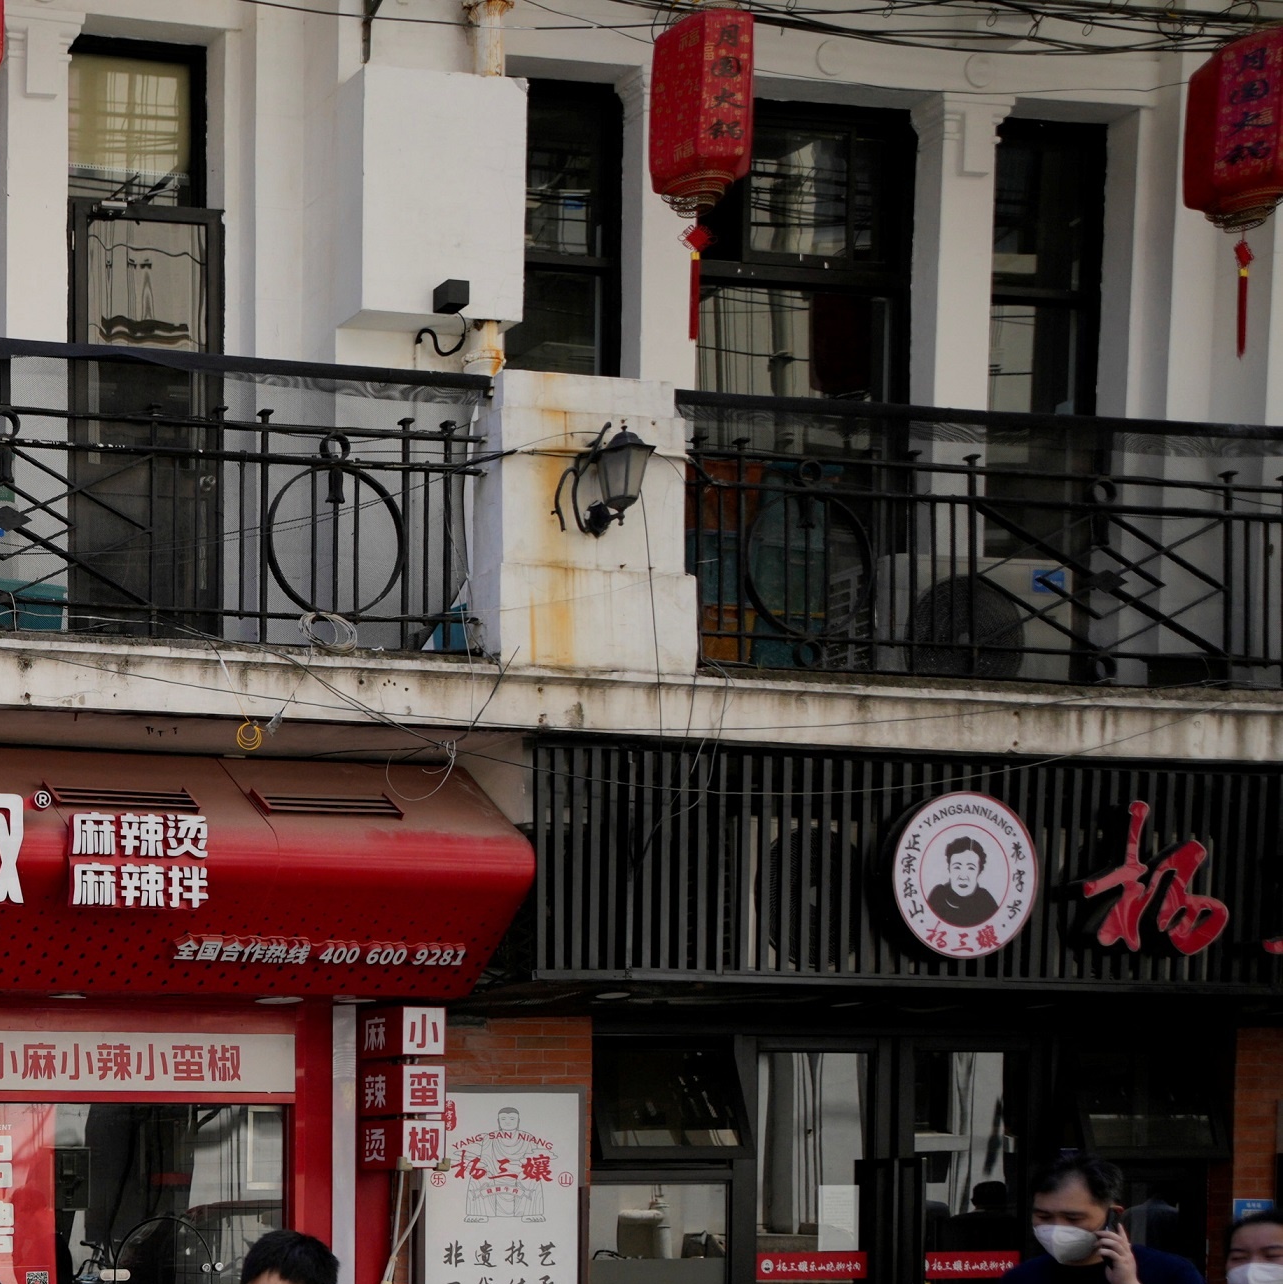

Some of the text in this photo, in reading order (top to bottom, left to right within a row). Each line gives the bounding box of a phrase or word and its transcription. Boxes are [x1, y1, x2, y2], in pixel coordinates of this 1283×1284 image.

[73, 812, 208, 859] 麻辣烫
[923, 804, 1014, 836] YANGSANNIANG
[73, 861, 208, 909] 麻辣拌
[1083, 800, 1283, 955] 杨
[173, 934, 466, 965] 全国合作热线 400 600 9281
[364, 1017, 386, 1162] 麻辣烫
[409, 1014, 439, 1161] 小蛮椒
[452, 1132, 553, 1151] YANG SAN NIANG
[432, 1173, 445, 1186] 乐
[559, 1174, 572, 1186] 山
[443, 1240, 556, 1267] 非遗技艺
